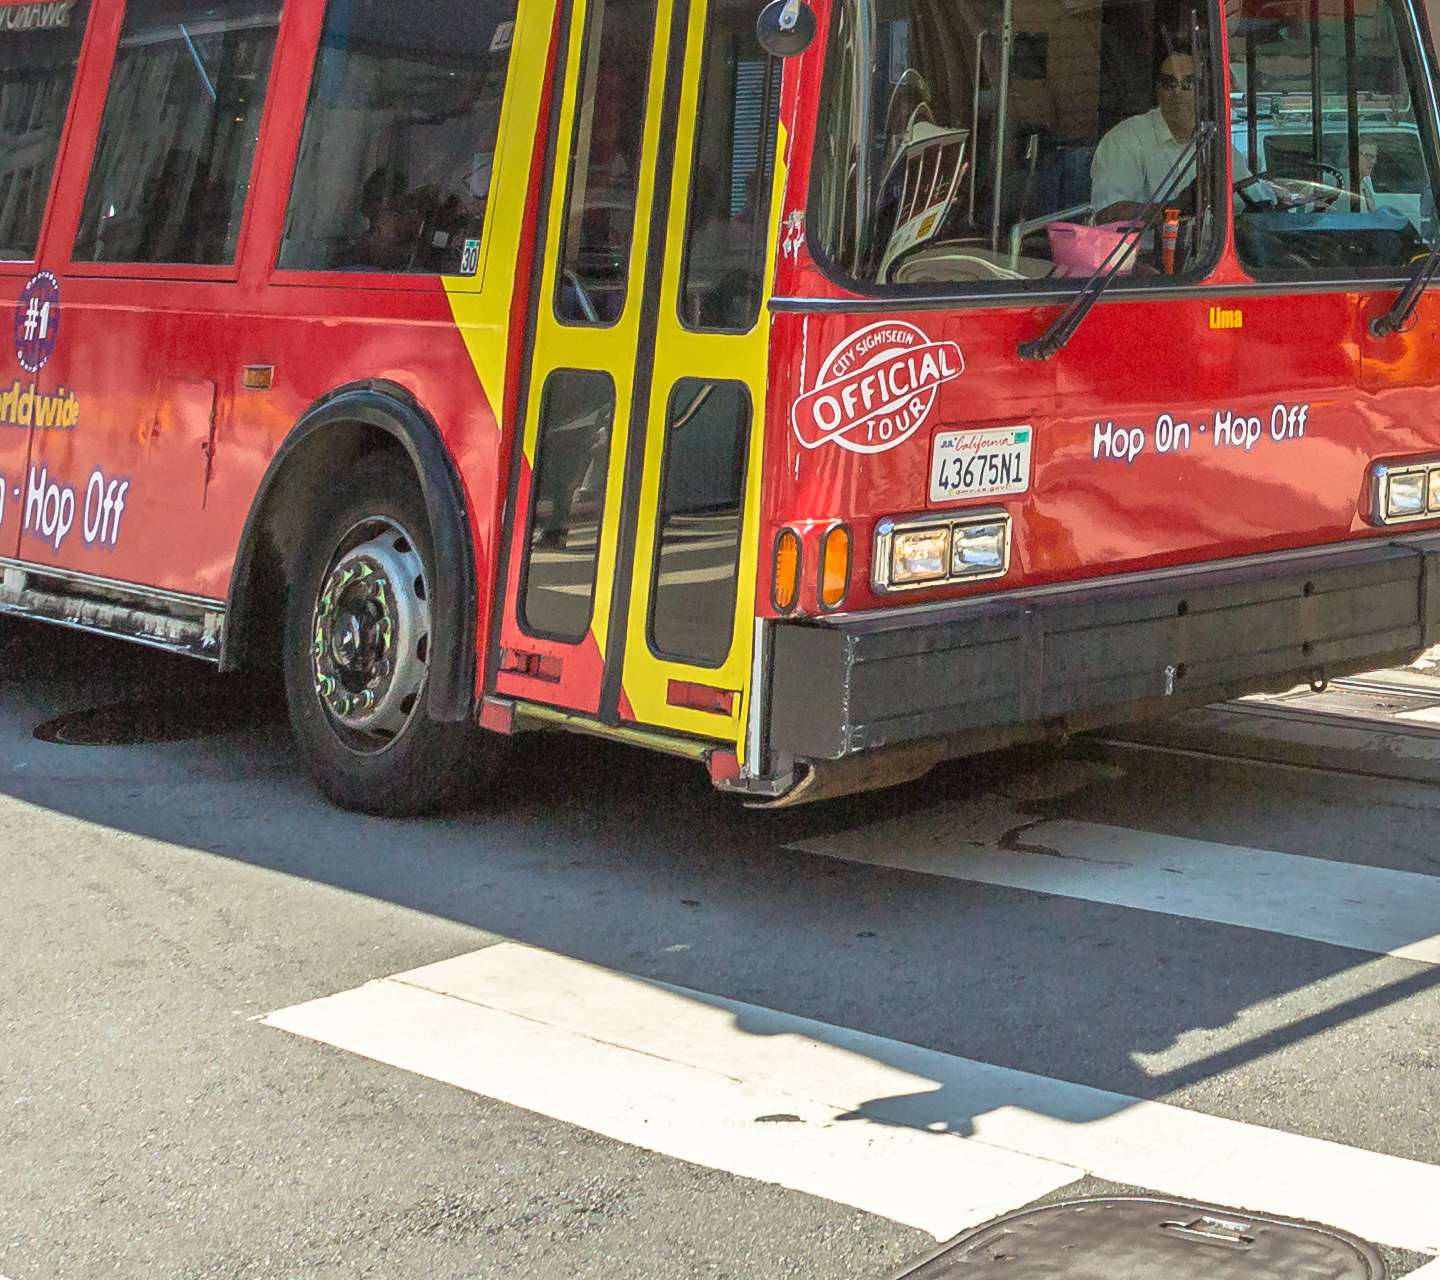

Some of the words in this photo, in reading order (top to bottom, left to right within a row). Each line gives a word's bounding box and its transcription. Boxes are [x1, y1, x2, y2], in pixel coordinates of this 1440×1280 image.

[461, 247, 477, 272] 30
[24, 297, 50, 340] #1
[1208, 307, 1243, 330] Lima
[832, 348, 857, 377] CITY
[812, 347, 956, 431] OFFICIAL
[866, 397, 926, 441] TOUR
[1091, 418, 1145, 464] Hop
[1155, 414, 1191, 451] On
[1213, 411, 1261, 452] Hop
[1269, 402, 1310, 442] Off
[954, 434, 1017, 454] California
[938, 451, 1023, 490] 43675N1
[25, 465, 75, 549] Hop
[83, 470, 130, 544] Off
